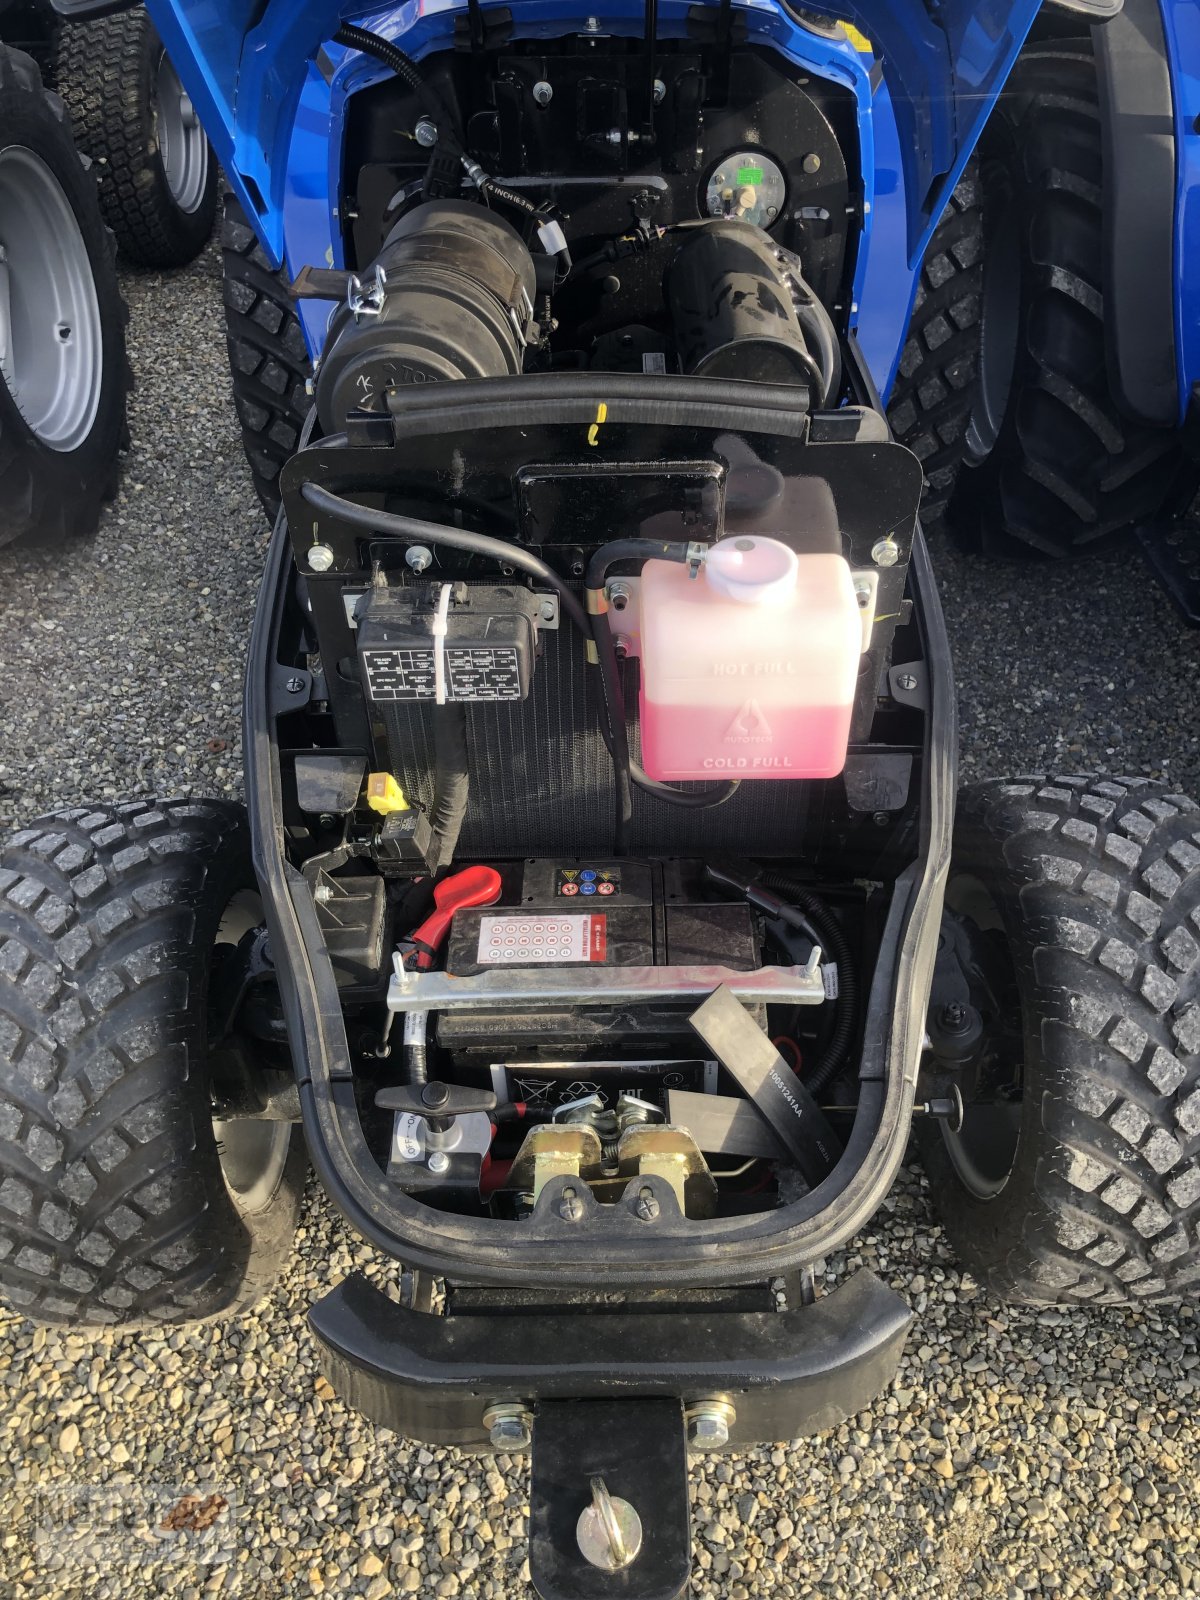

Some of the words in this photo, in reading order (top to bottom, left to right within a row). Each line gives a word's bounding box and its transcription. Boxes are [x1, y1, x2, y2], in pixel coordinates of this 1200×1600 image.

[494, 186, 514, 200] INCH
[714, 662, 748, 676] HOT
[754, 662, 796, 674] FULL
[704, 758, 746, 768] COLD
[753, 757, 792, 768] FULL
[769, 1068, 803, 1118] 10051241AA
[405, 1139, 415, 1154] OFF
